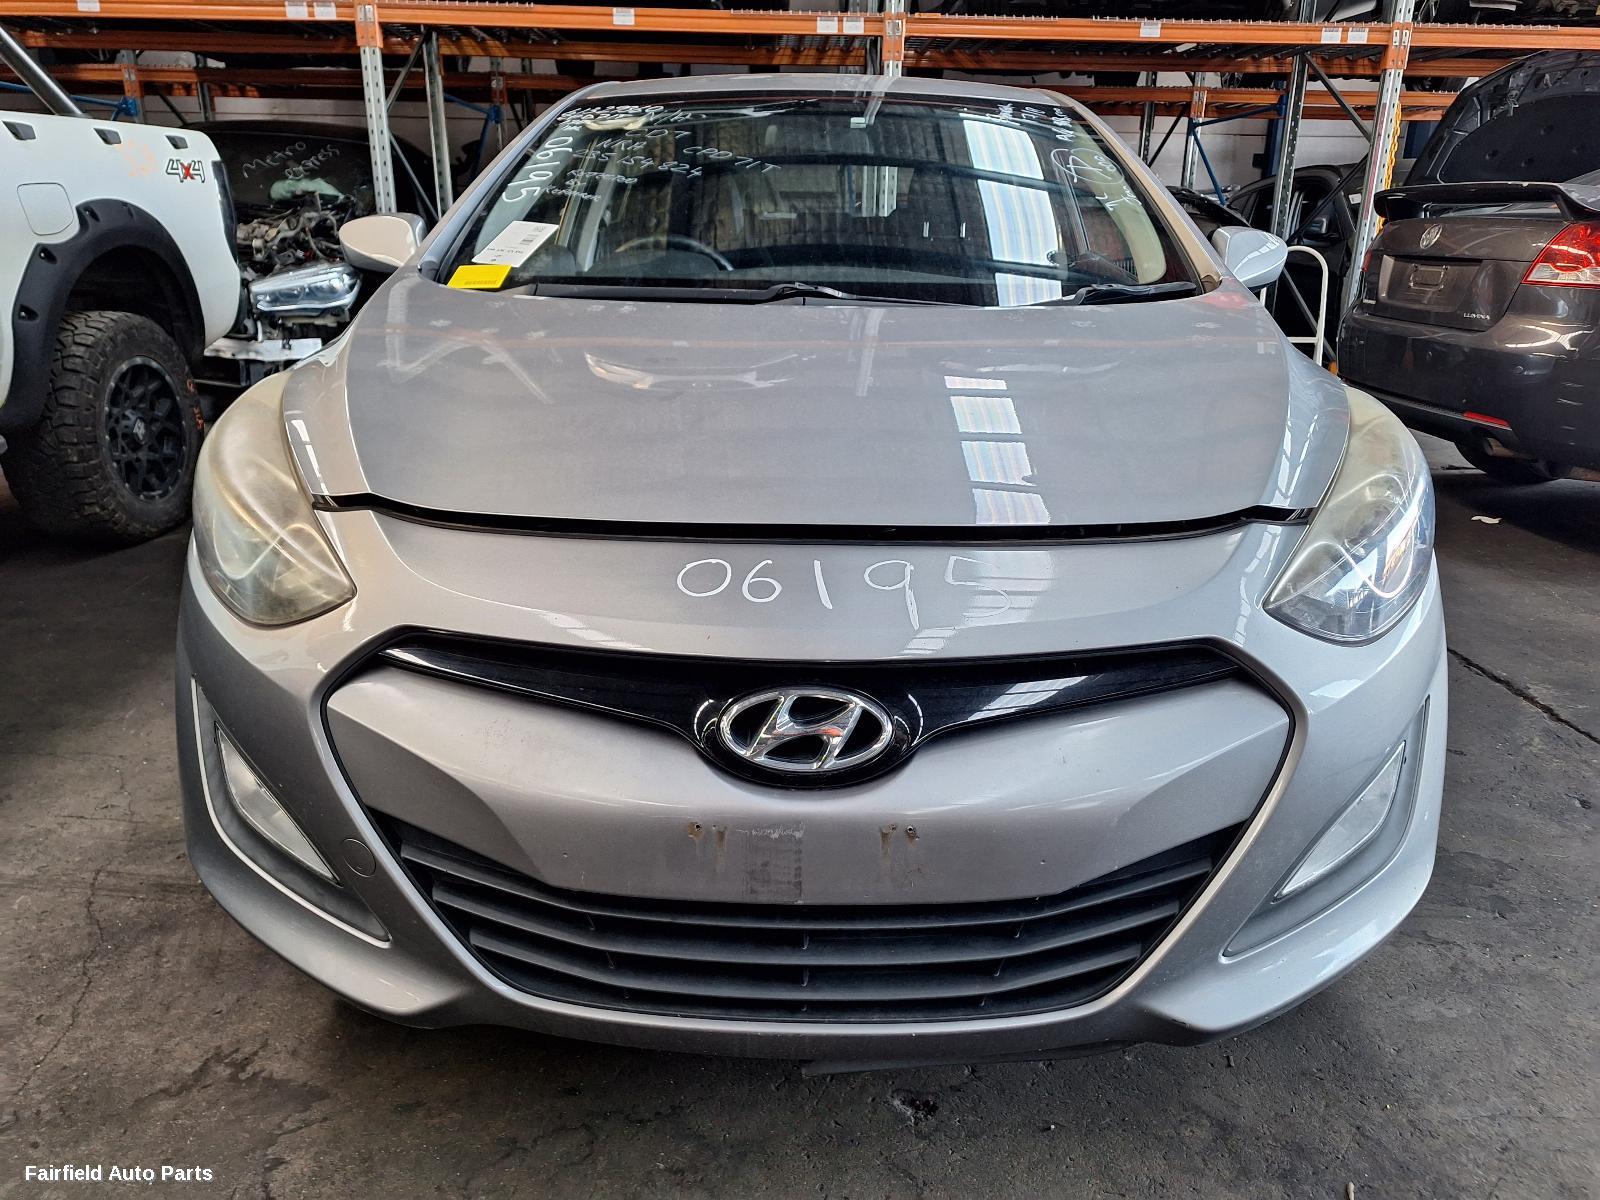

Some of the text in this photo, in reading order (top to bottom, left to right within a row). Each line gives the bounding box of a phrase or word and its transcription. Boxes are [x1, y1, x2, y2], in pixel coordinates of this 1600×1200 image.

[242, 141, 306, 178] Metro
[502, 136, 573, 202] 06195
[676, 555, 1011, 631] 06195
